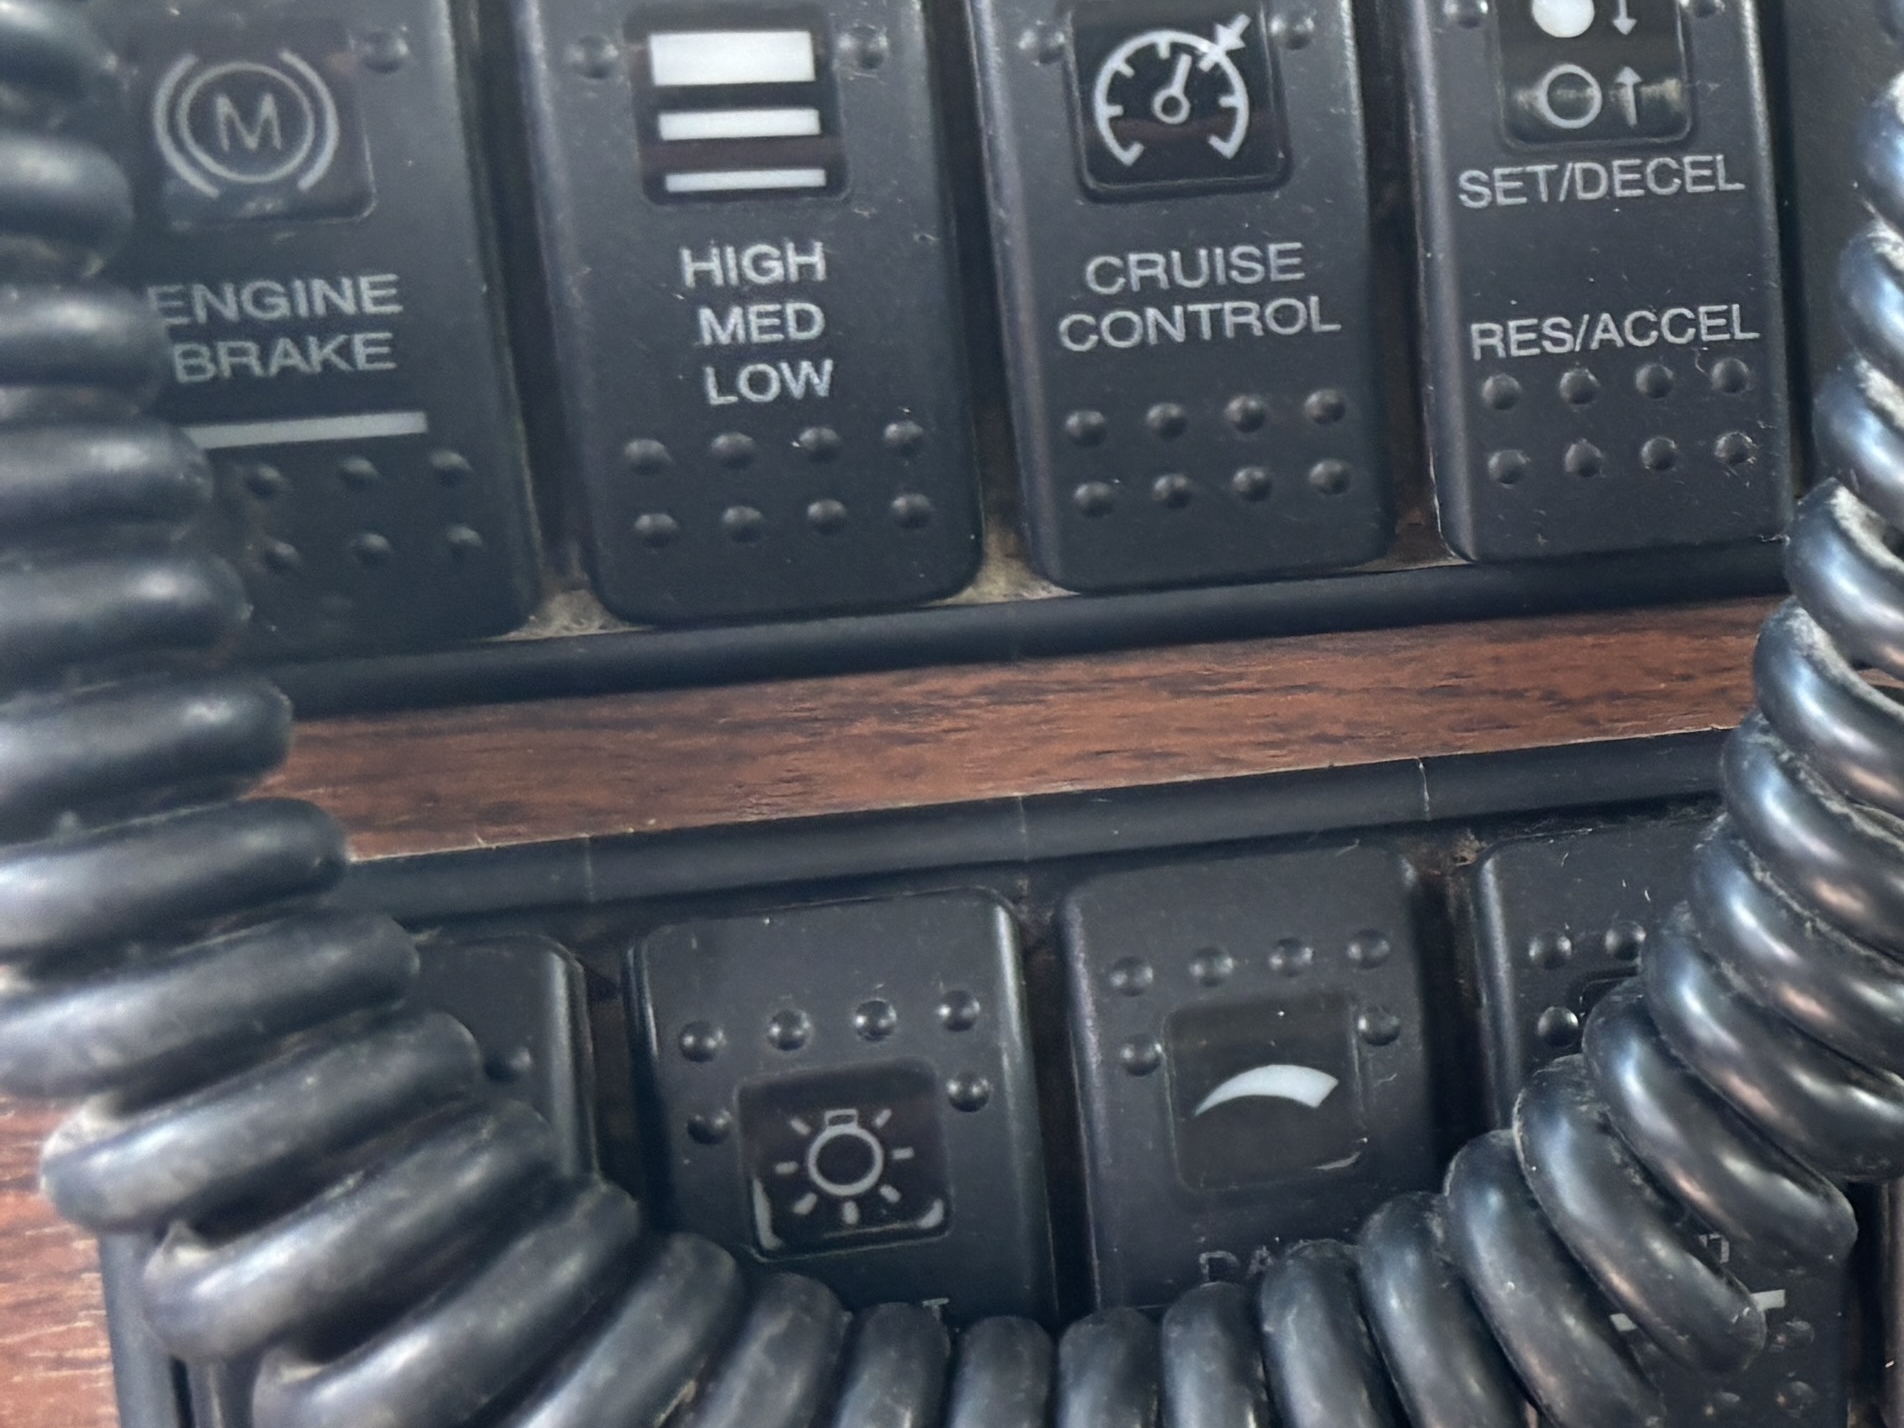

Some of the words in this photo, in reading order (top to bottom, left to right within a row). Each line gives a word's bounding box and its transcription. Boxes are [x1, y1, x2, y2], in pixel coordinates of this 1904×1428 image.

[1457, 154, 1746, 210] SET/DECEL
[680, 240, 826, 287] HIGH
[1084, 240, 1305, 296] CRUISE
[147, 274, 403, 324] ENGINE
[697, 301, 826, 347] MED
[1058, 295, 1341, 354] CONTROL
[172, 332, 397, 384] BRAKE
[1470, 304, 1760, 363] RES/ACCEL
[704, 359, 834, 407] LOW
